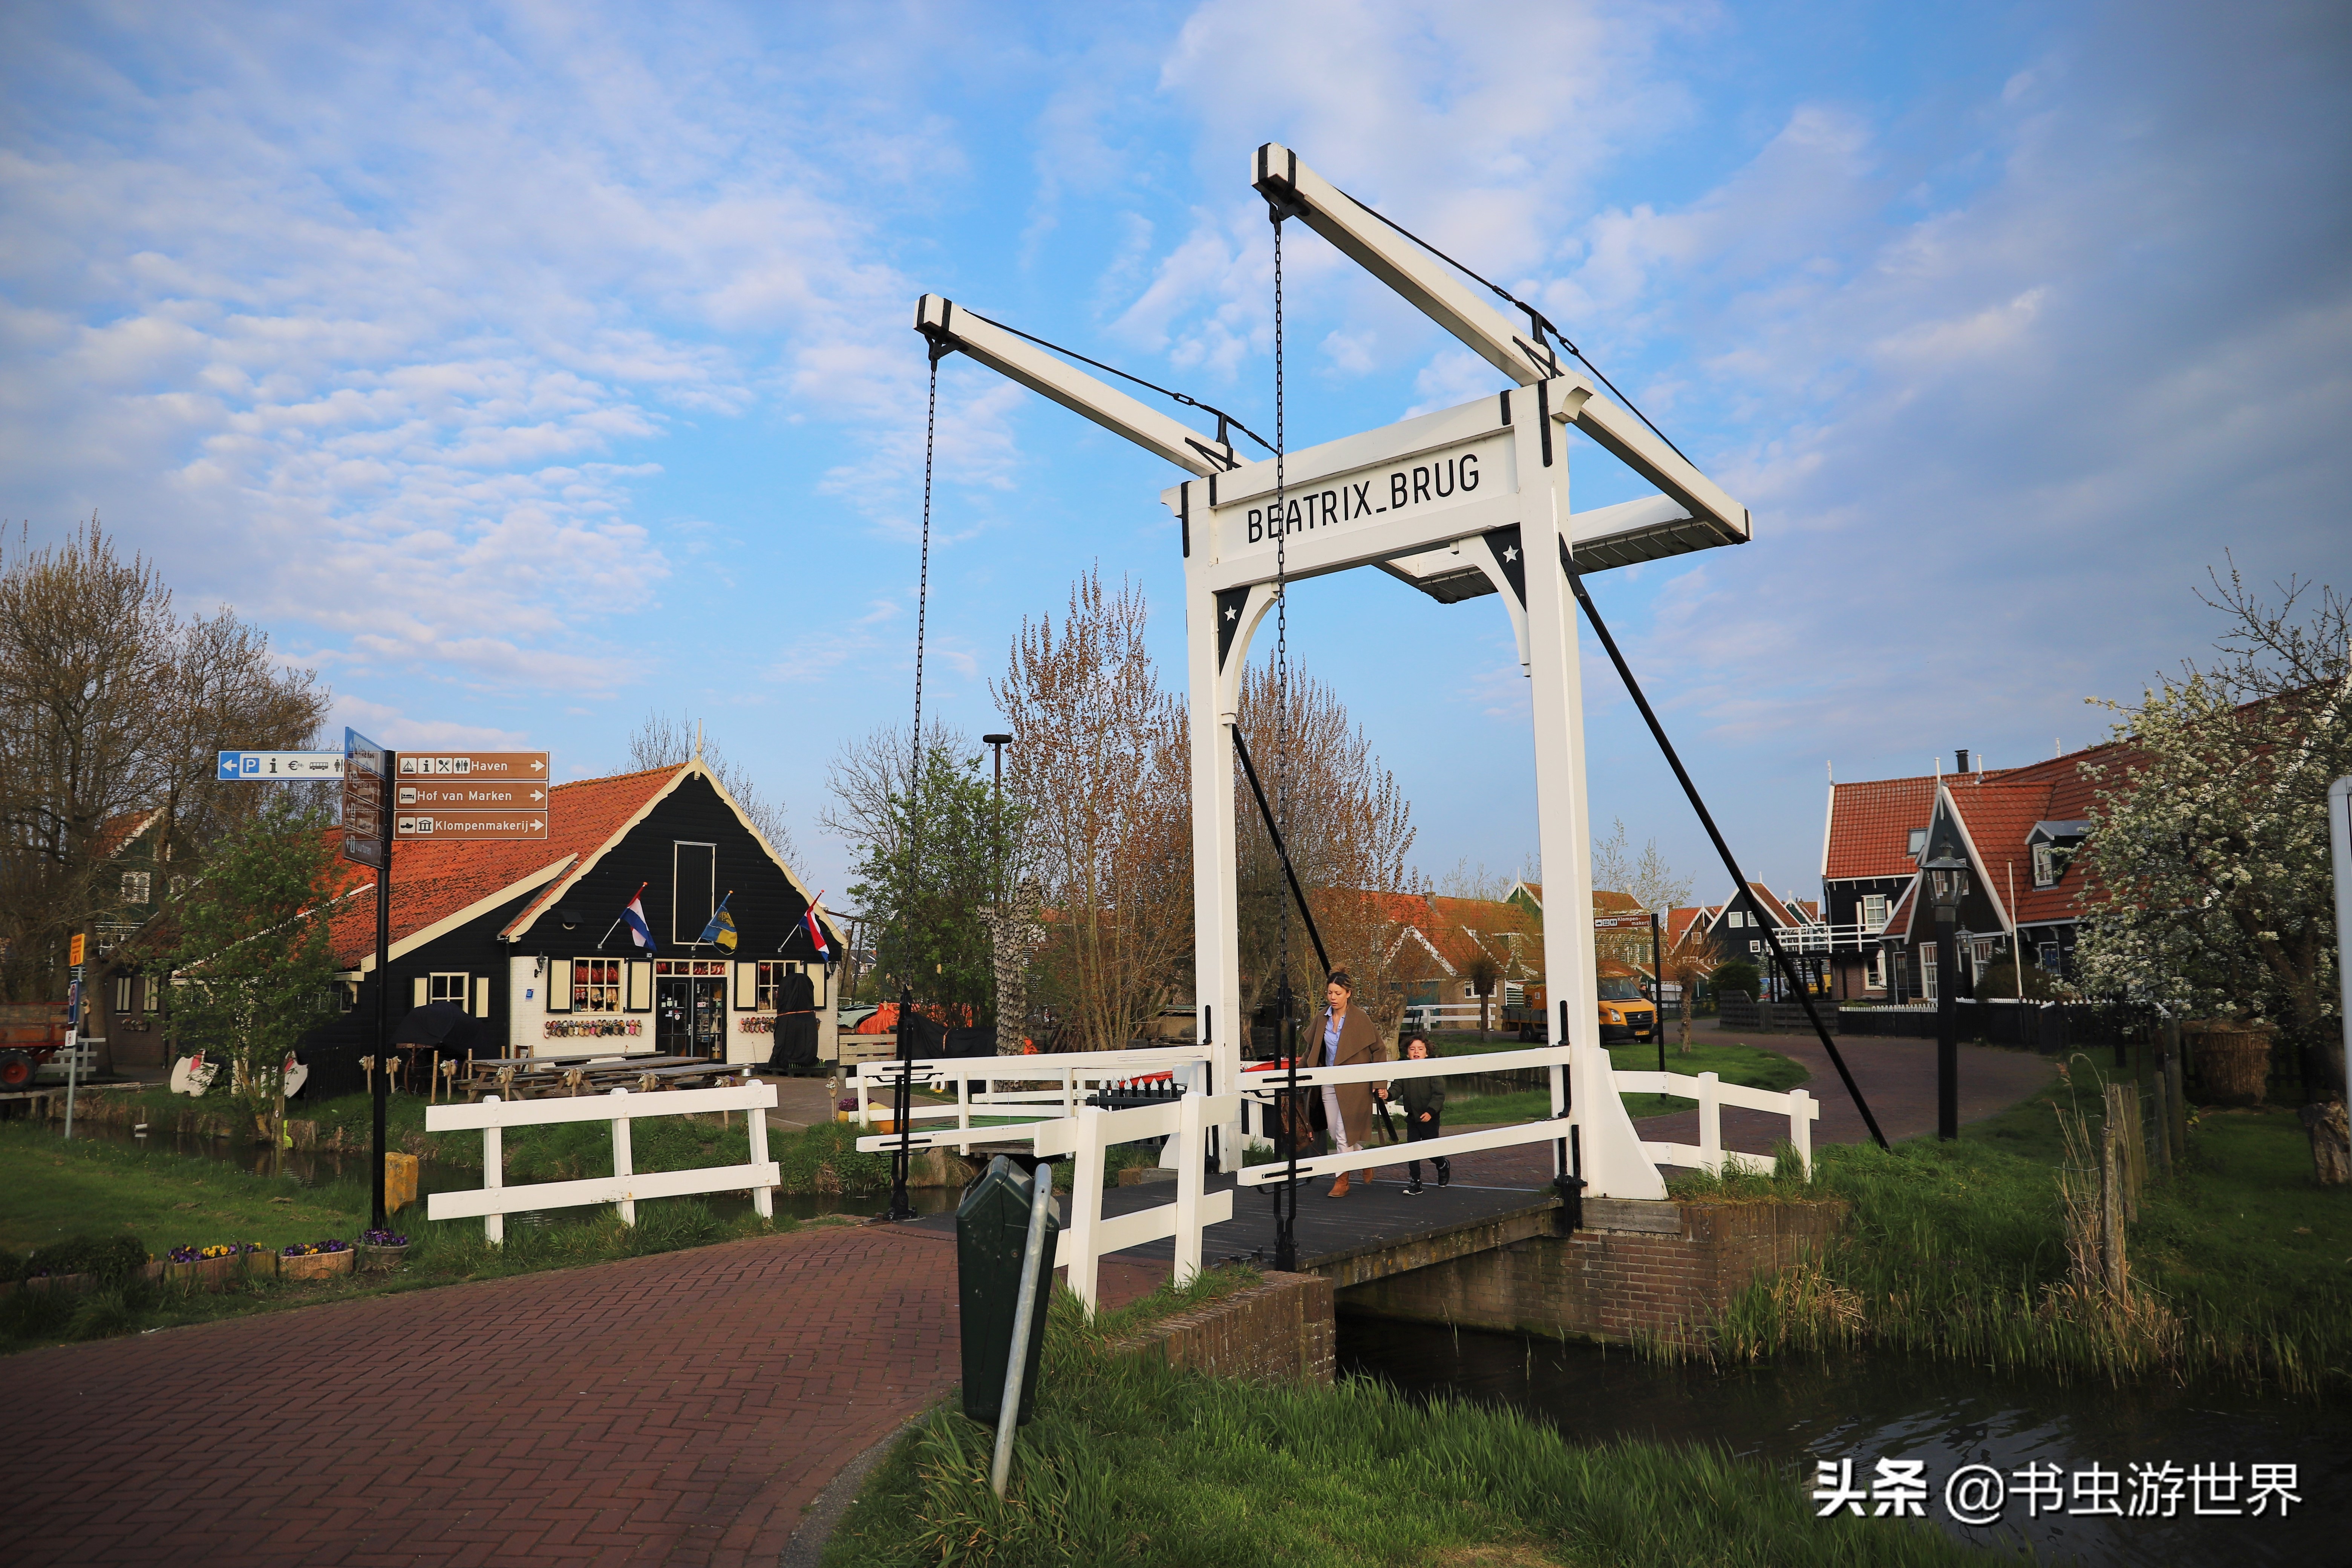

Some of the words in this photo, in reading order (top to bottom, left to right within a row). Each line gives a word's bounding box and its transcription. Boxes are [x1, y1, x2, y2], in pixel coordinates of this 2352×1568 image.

[471, 761, 507, 770] Haven
[417, 791, 437, 801] Hof
[469, 791, 511, 801] Marken
[435, 821, 528, 833] Klompenmakerij
